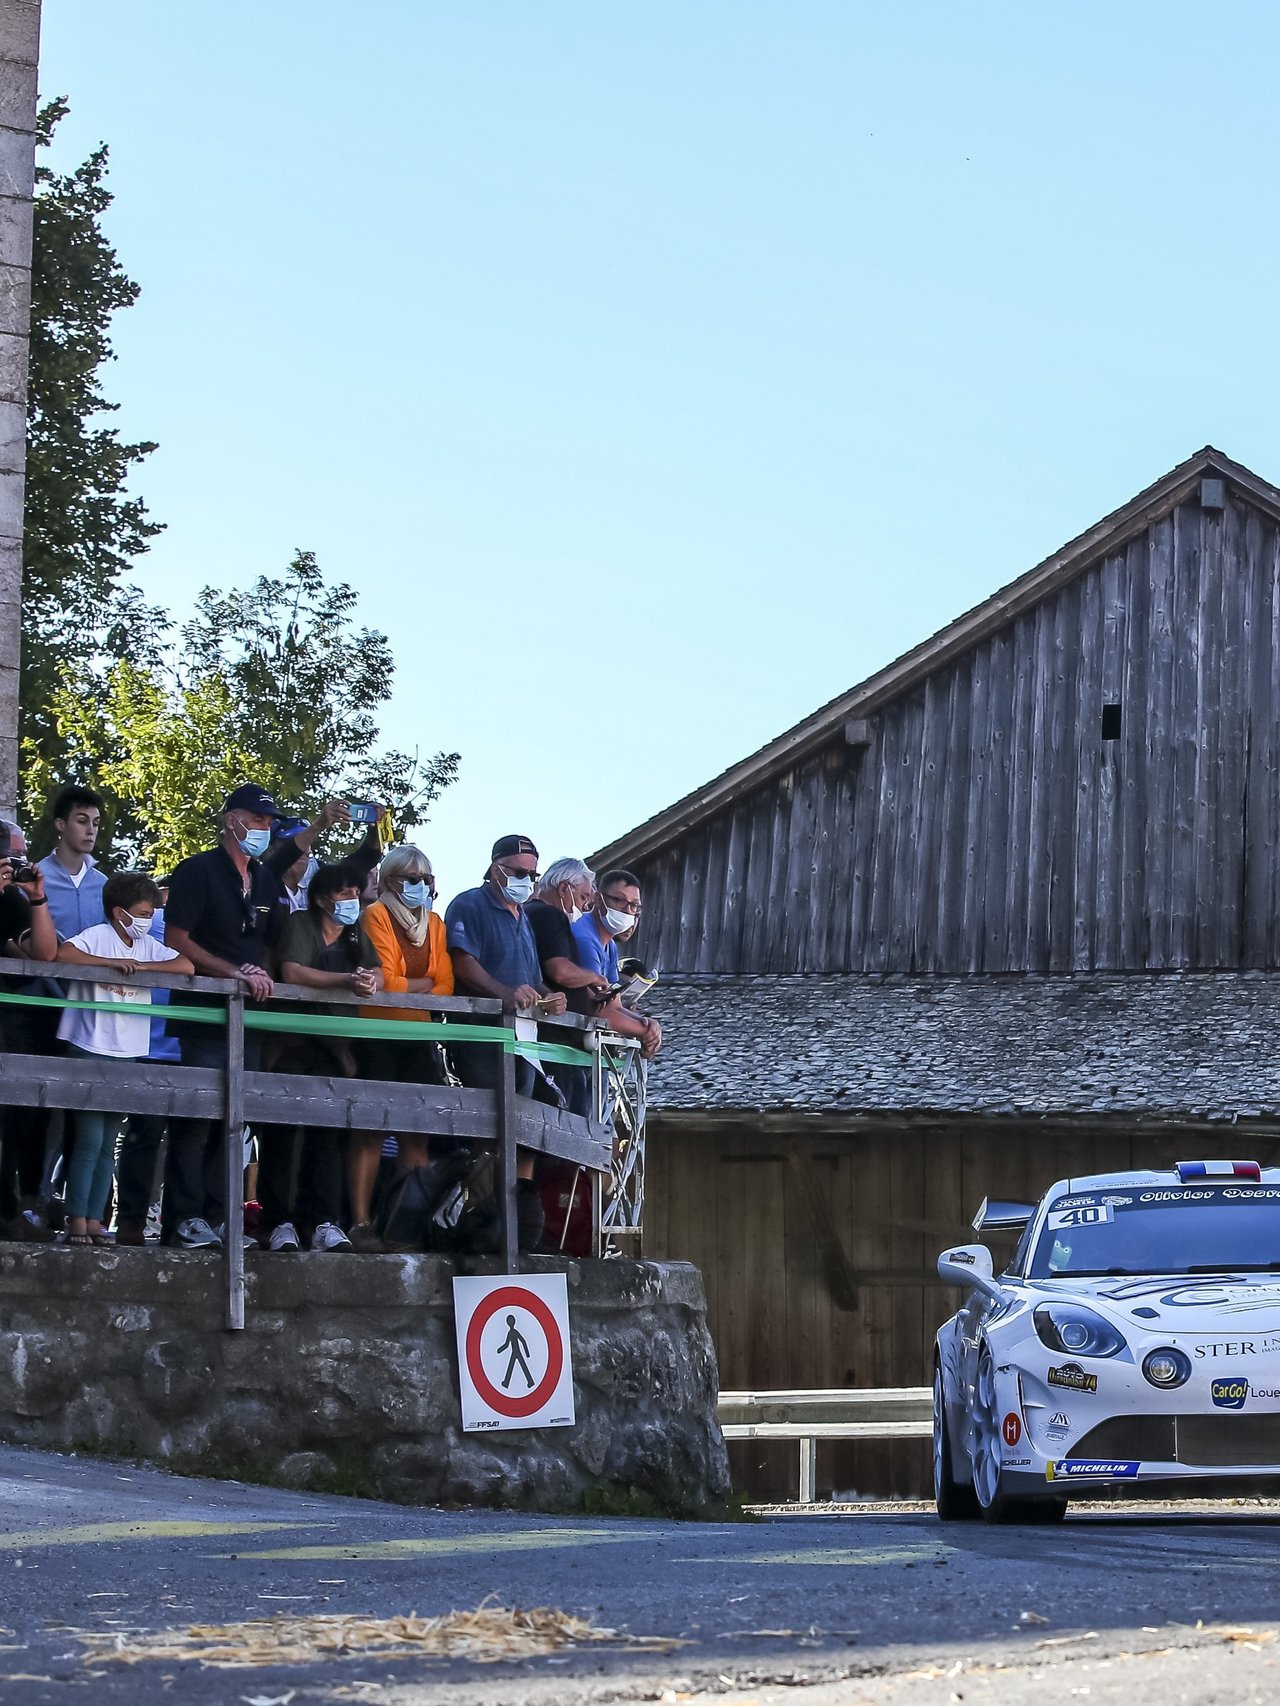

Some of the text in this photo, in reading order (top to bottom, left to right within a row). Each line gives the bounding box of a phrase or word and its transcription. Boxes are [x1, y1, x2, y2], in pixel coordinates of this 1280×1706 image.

[1139, 1190, 1216, 1202] Olivier
[1059, 1208, 1100, 1225] 40
[1194, 1341, 1257, 1359] STER
[1213, 1382, 1248, 1399] CarGo!
[1070, 1464, 1128, 1473] MICHELIN
